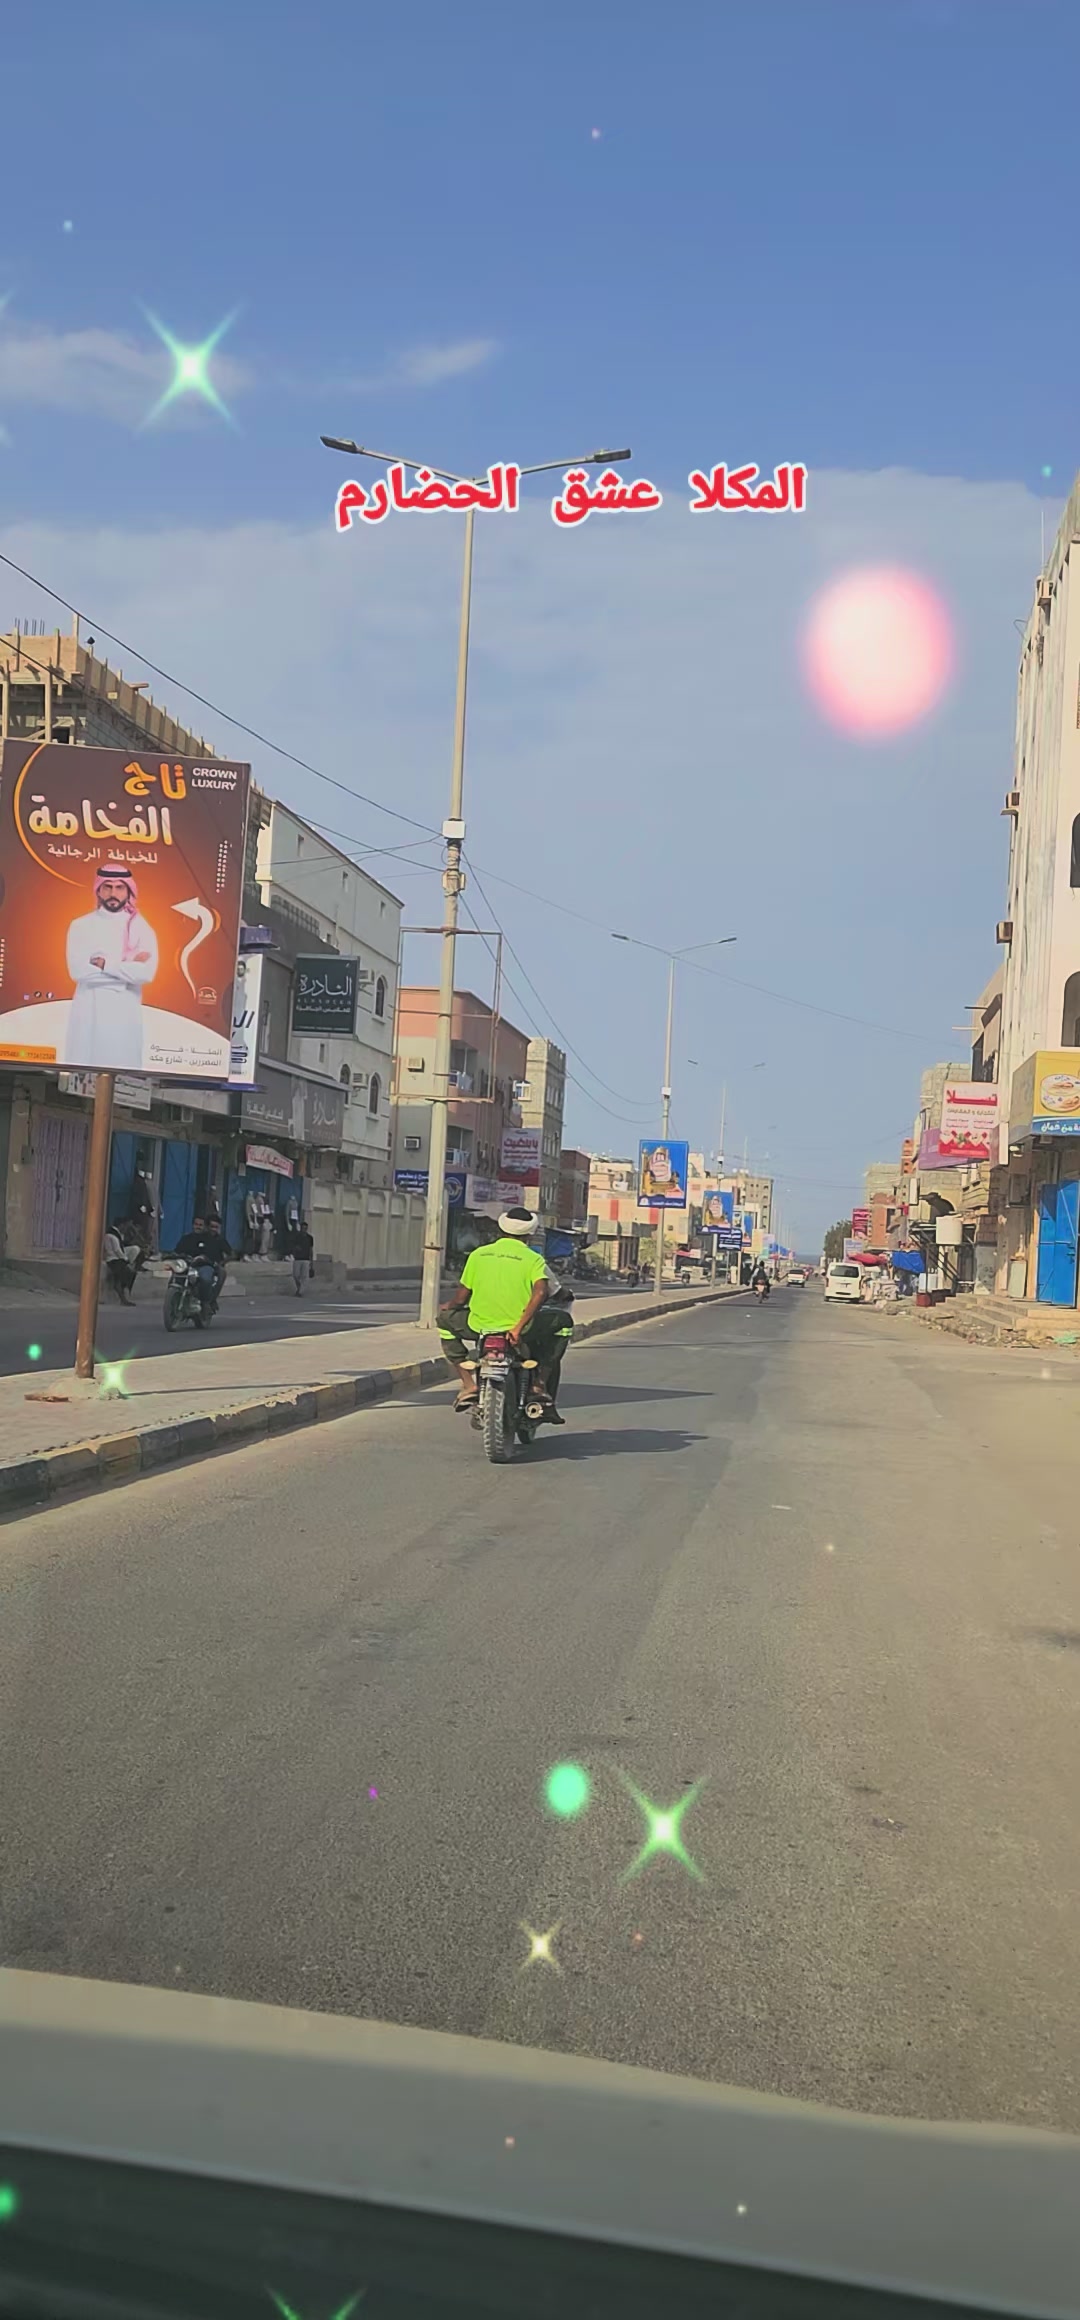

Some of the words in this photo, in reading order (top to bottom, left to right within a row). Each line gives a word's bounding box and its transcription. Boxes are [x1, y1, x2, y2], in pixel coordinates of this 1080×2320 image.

[123, 761, 187, 800] تاج
[192, 767, 237, 780] CROWN
[191, 779, 236, 791] LUXURY
[28, 795, 173, 846] الفخامة
[47, 842, 101, 862] الرجالية
[107, 848, 158, 864] للخياطة
[297, 974, 353, 997] النادرة
